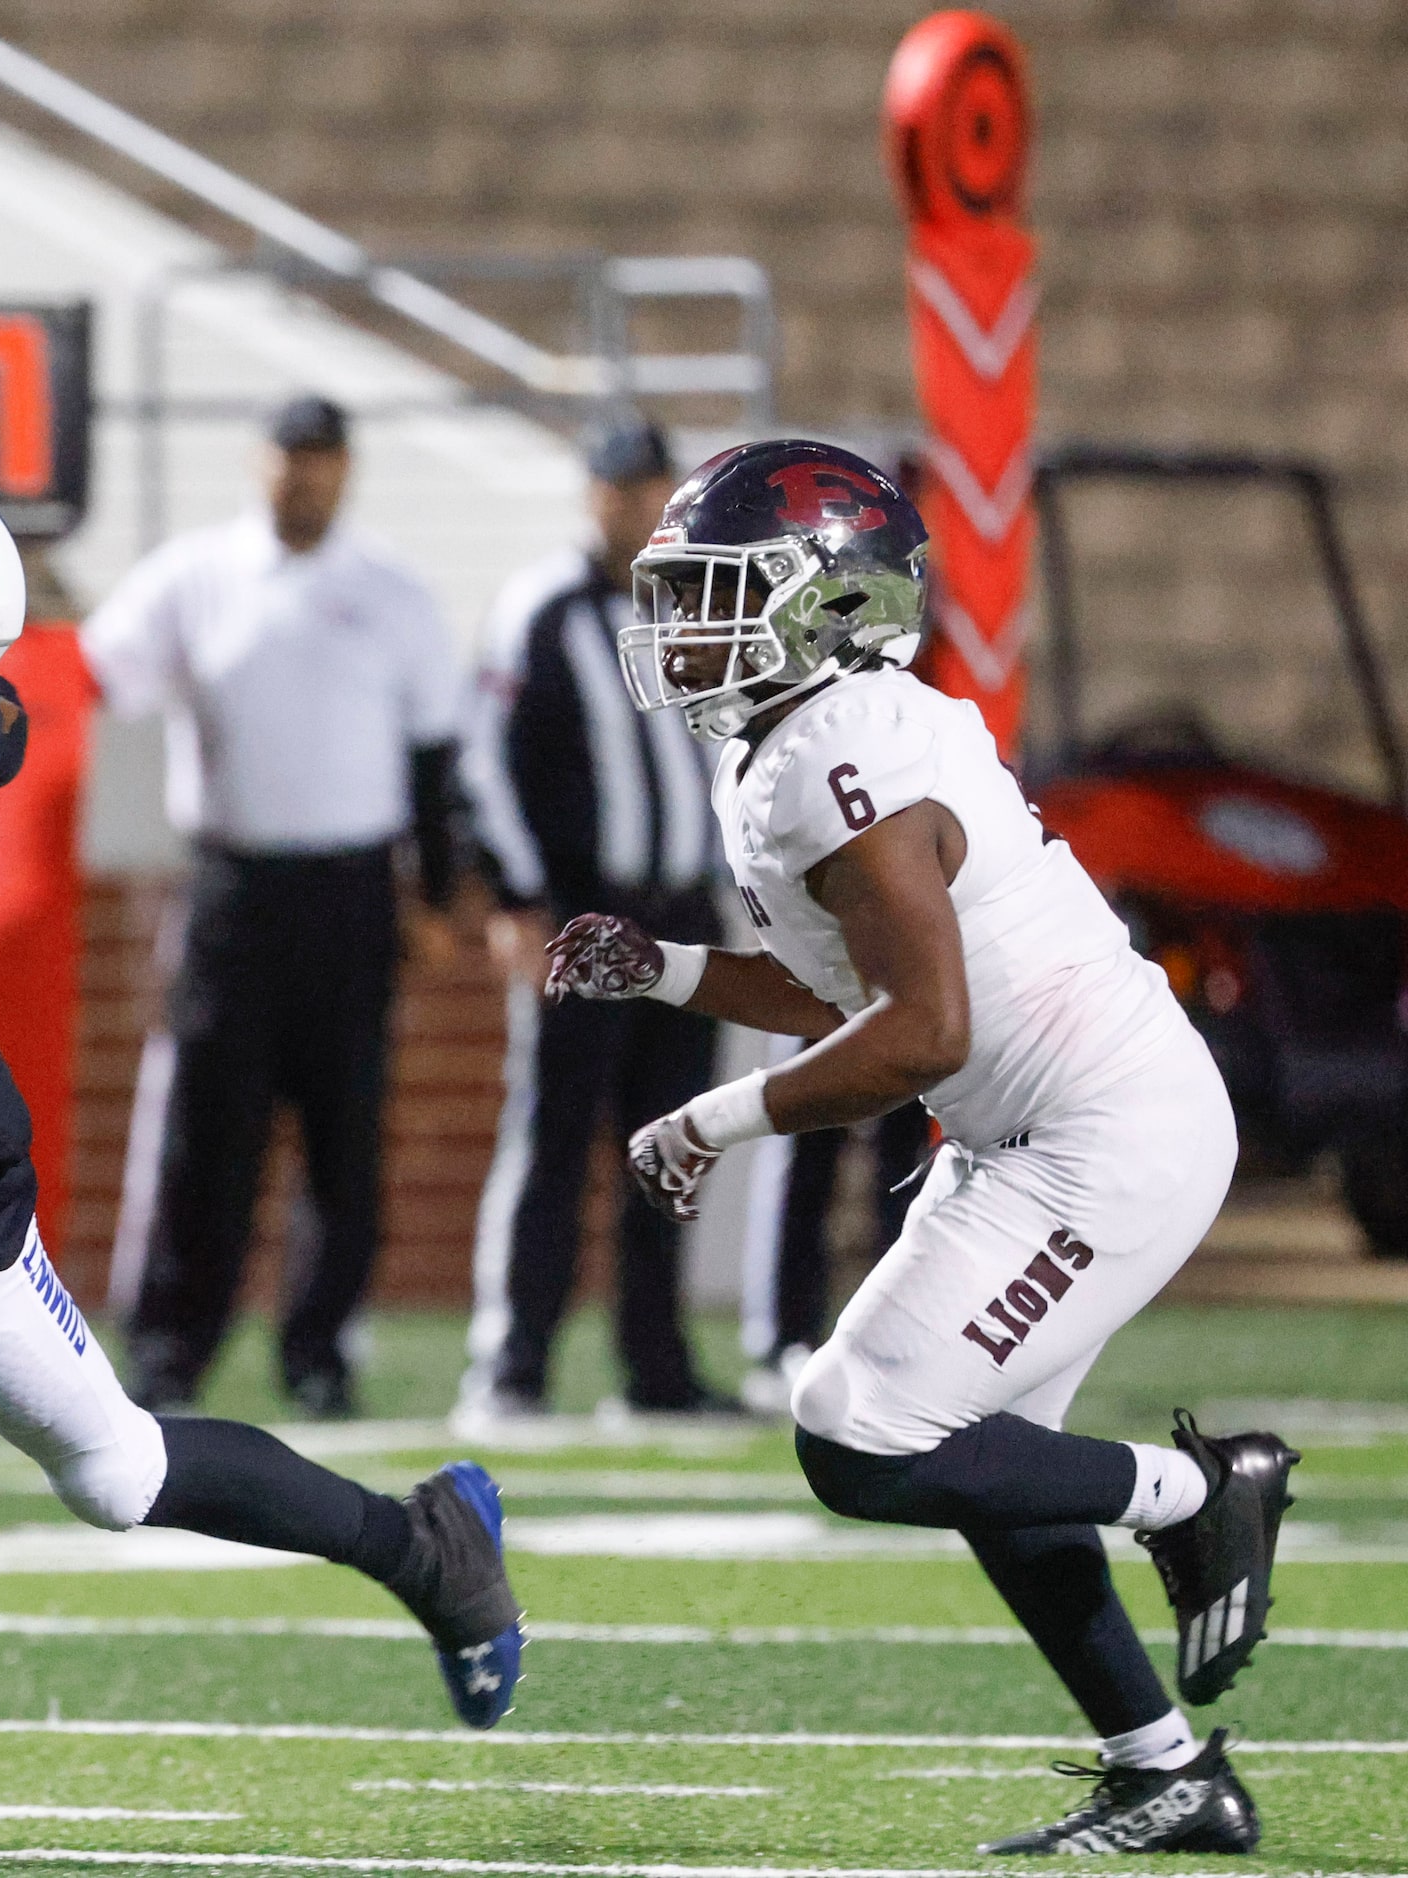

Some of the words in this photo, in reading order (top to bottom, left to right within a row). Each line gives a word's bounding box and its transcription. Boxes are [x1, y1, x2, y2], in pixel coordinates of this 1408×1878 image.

[766, 462, 888, 531] E
[827, 762, 877, 831] 6
[961, 1229, 1094, 1367] LIONS
